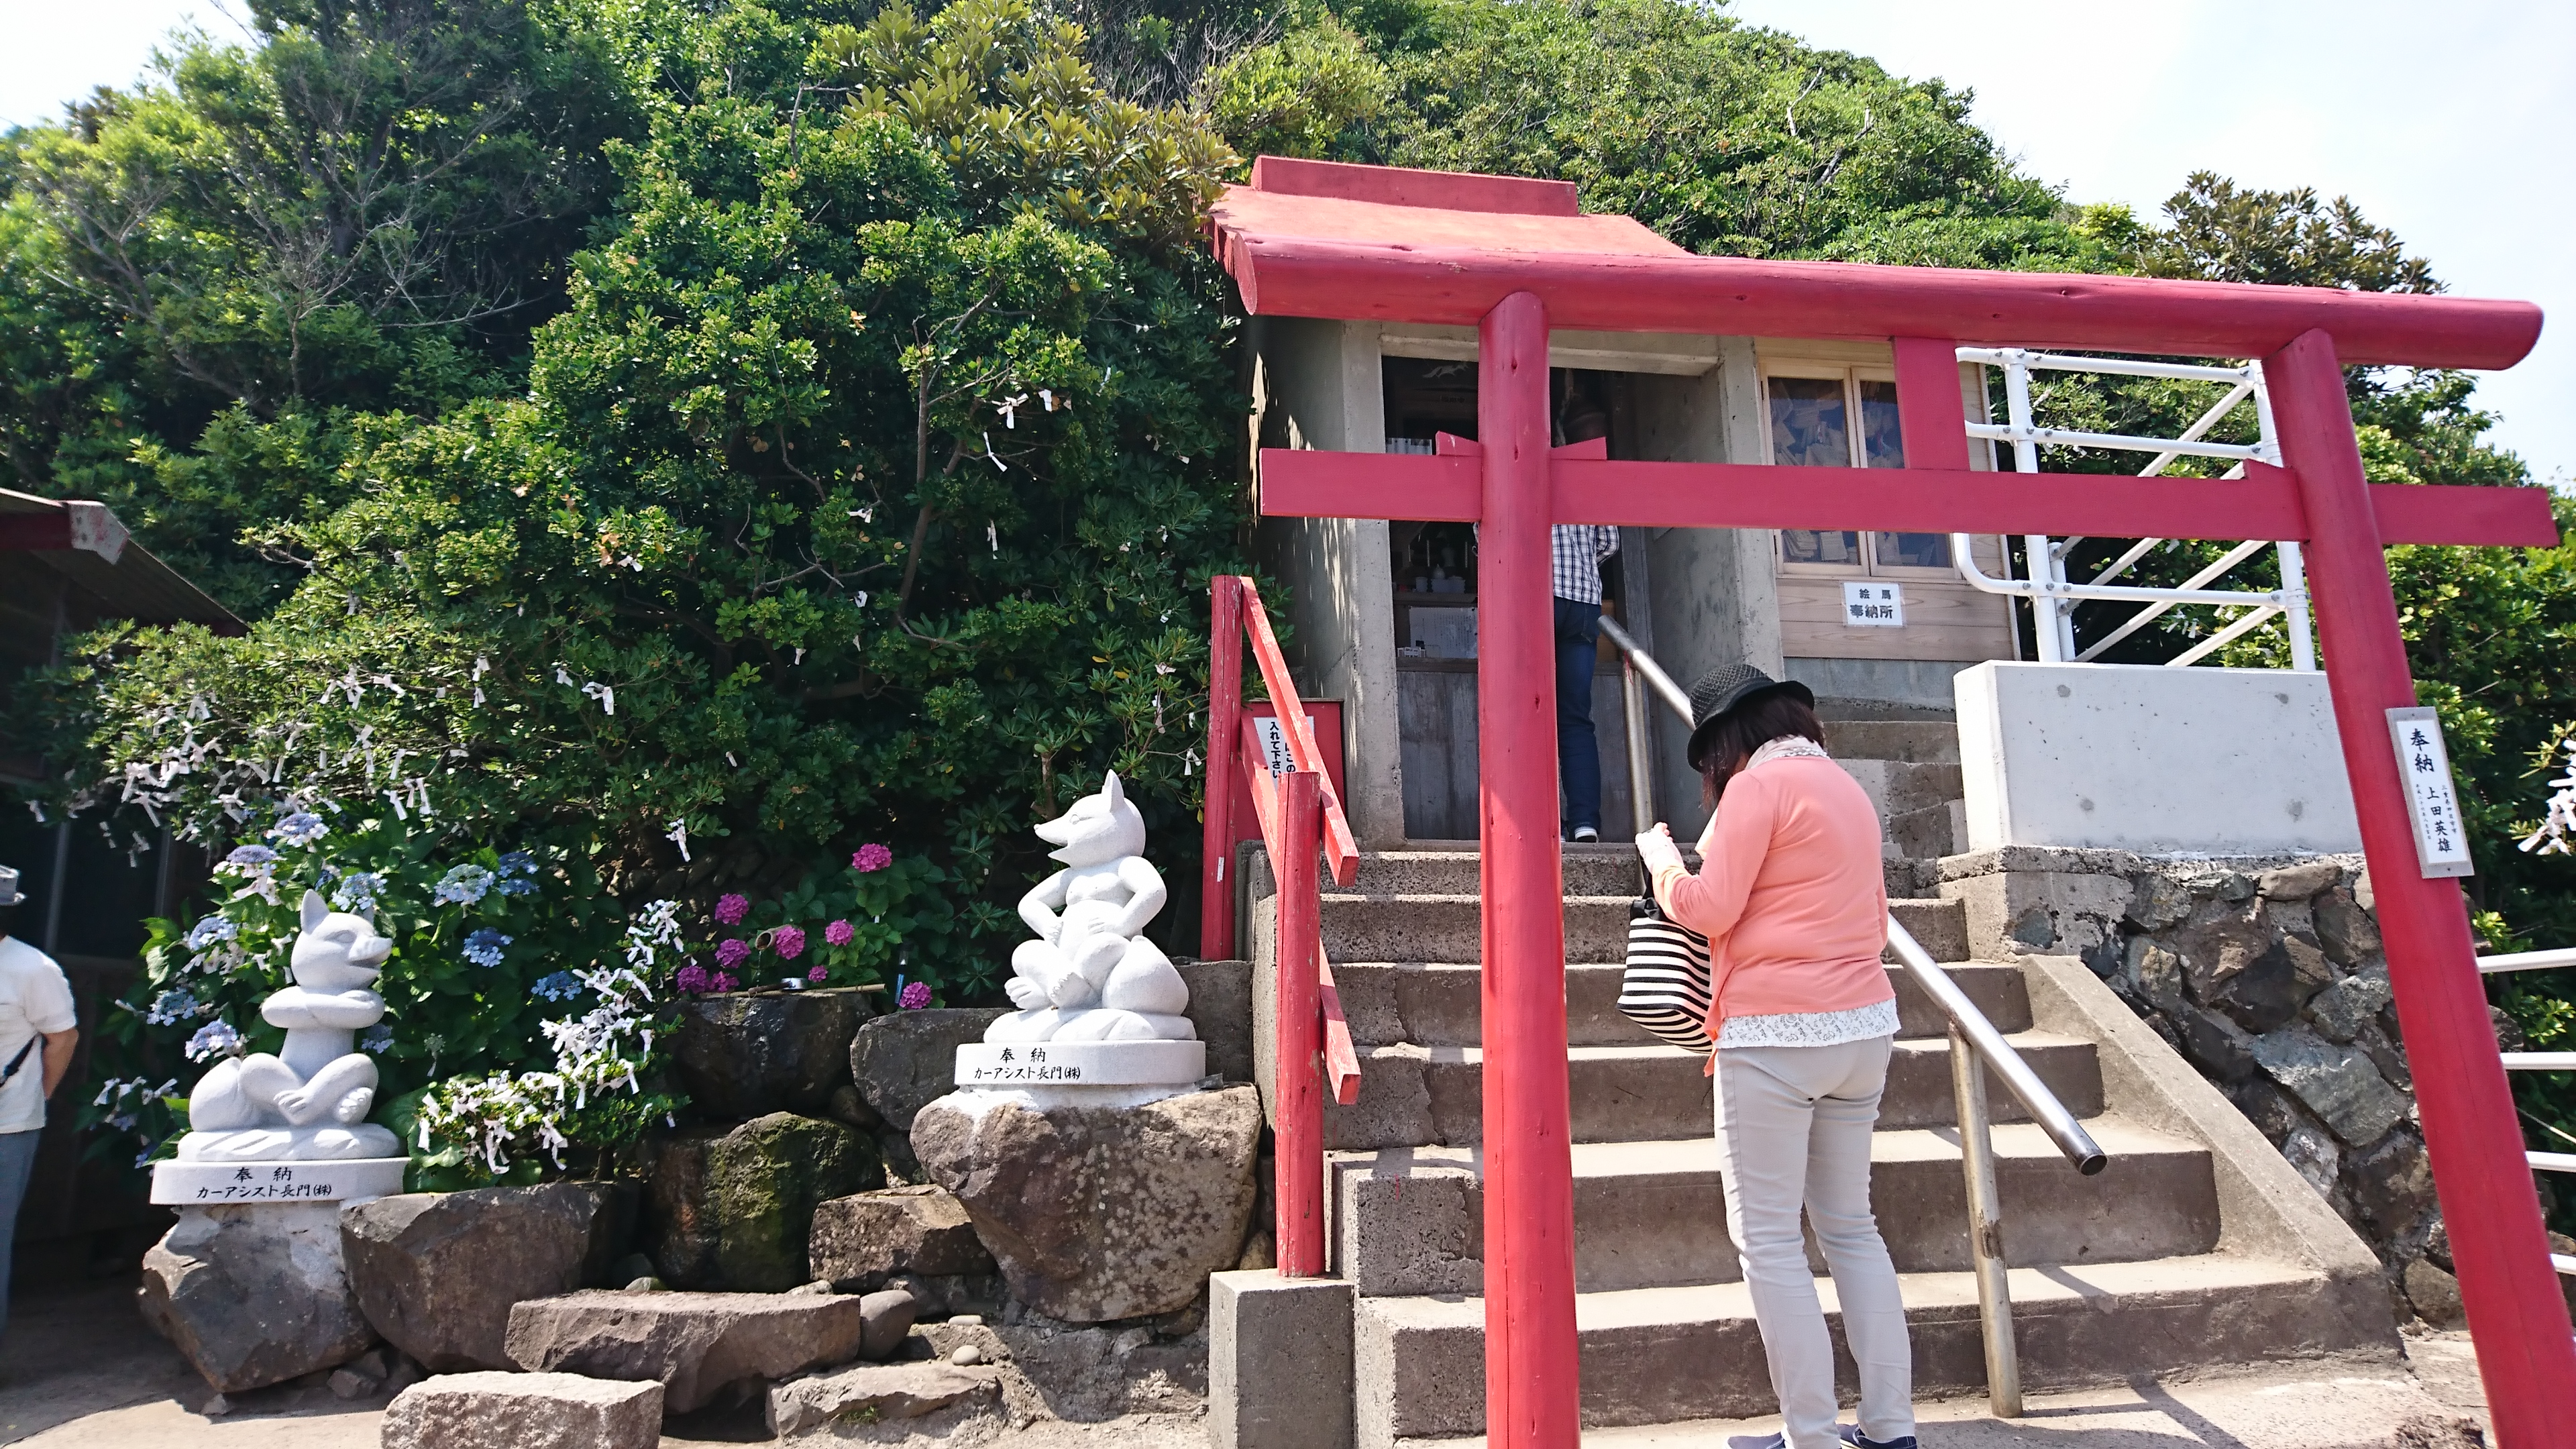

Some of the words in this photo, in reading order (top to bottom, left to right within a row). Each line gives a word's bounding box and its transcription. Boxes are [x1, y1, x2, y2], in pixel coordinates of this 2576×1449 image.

[1859, 589, 1892, 600] 絵馬
[1849, 604, 1893, 619] 奉納所
[2410, 728, 2435, 773] 奉納
[2426, 786, 2453, 853] 上田英雄
[1000, 1047, 1046, 1064] 奉納
[233, 1167, 292, 1183] 奉納
